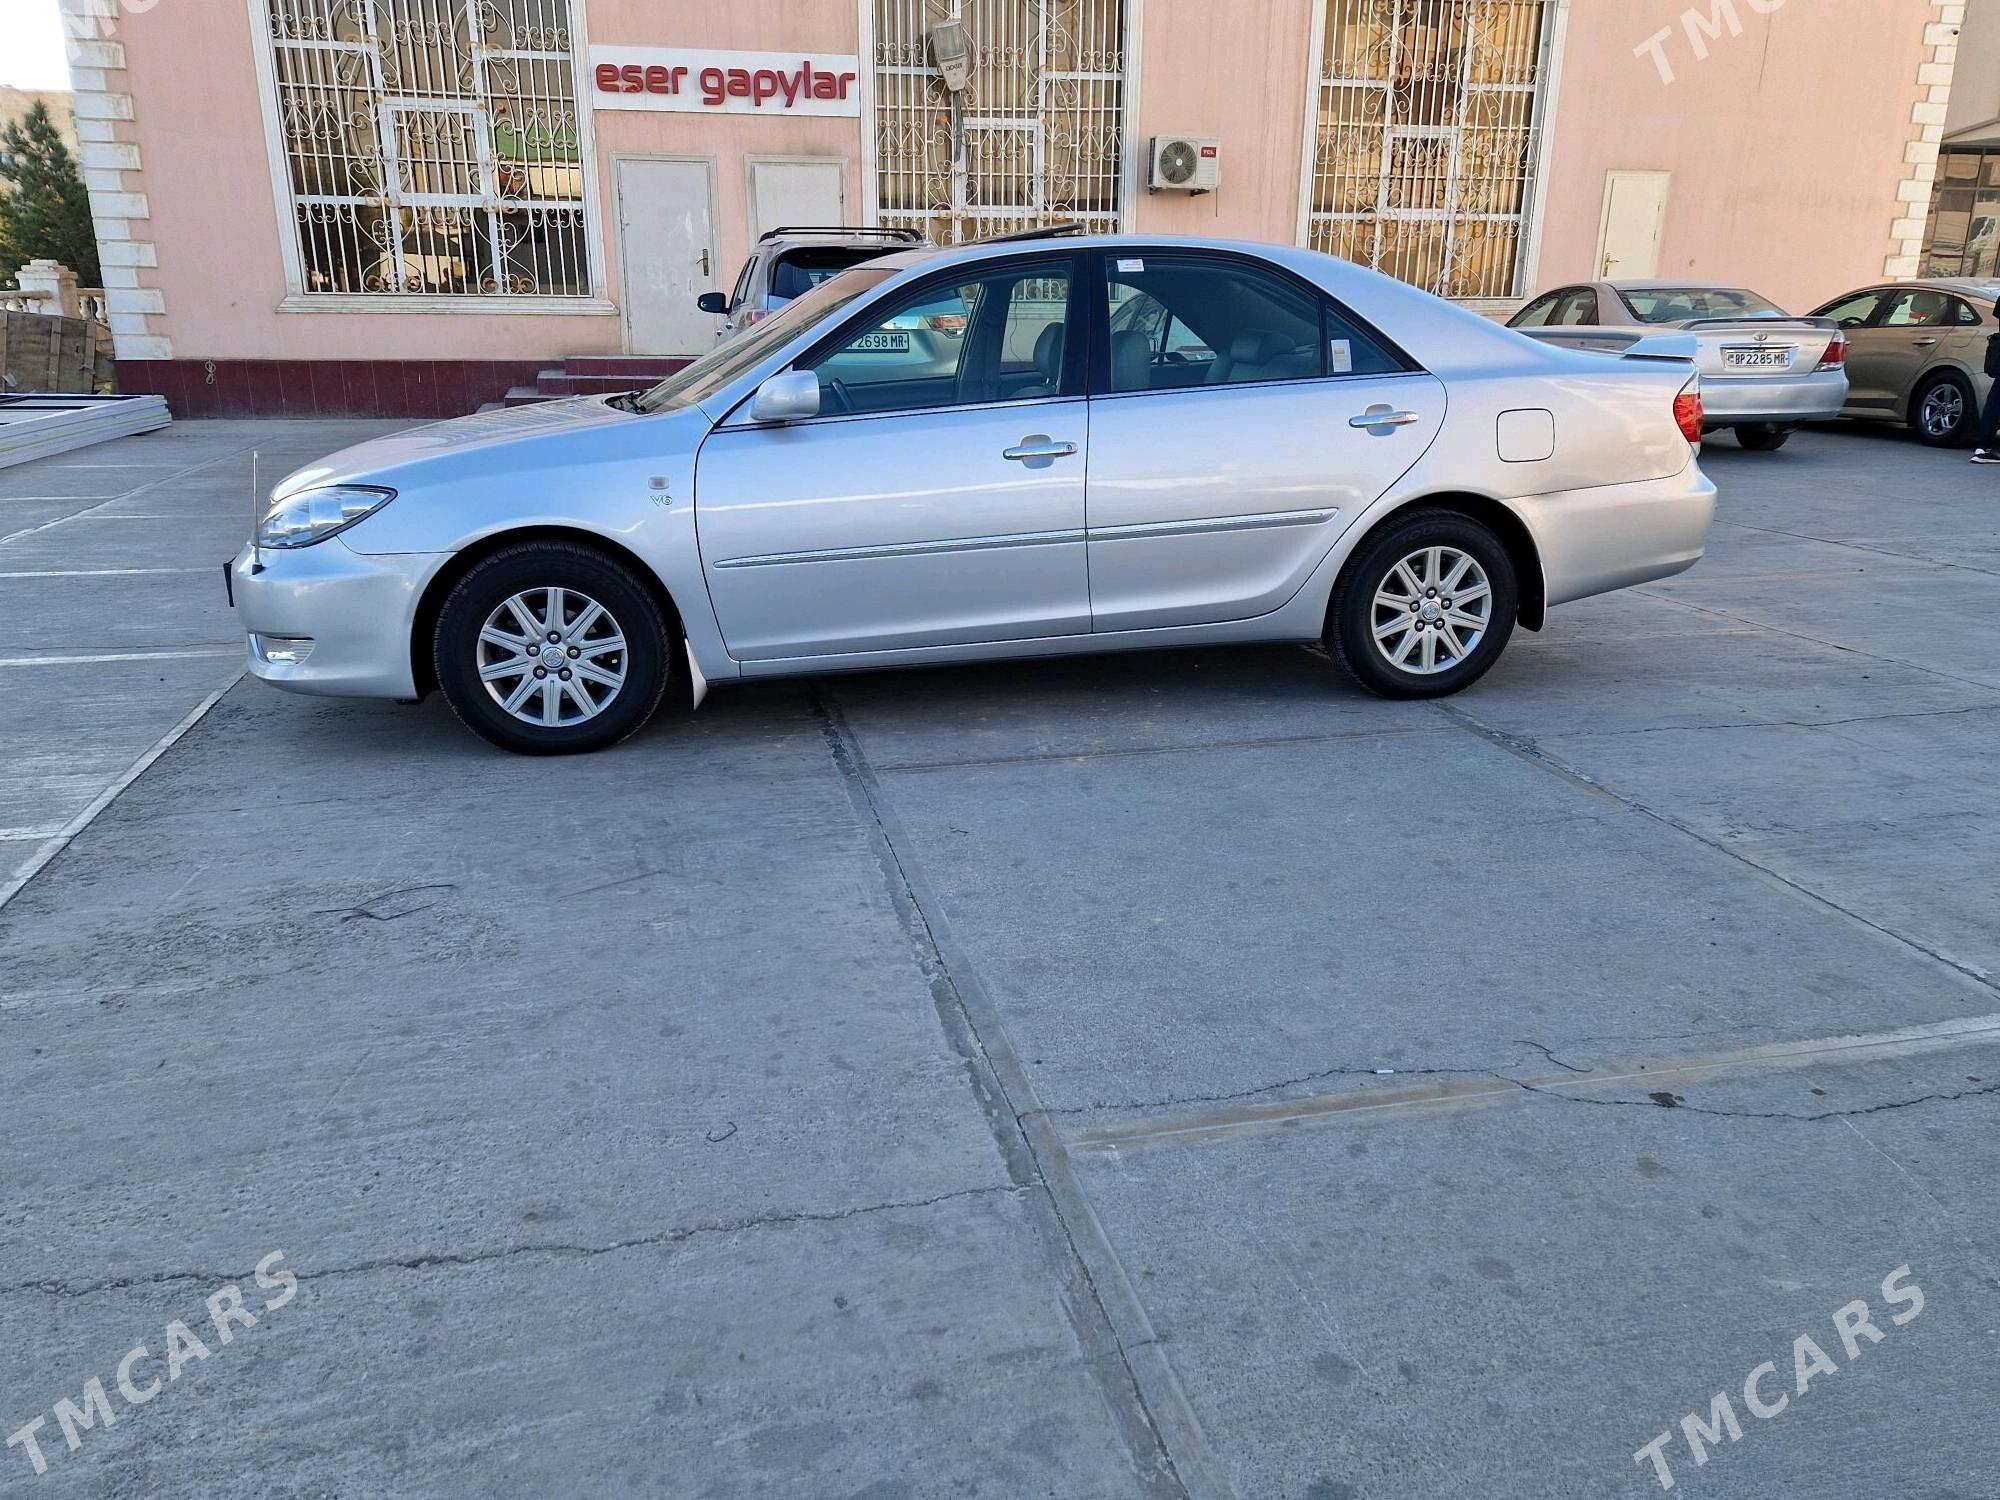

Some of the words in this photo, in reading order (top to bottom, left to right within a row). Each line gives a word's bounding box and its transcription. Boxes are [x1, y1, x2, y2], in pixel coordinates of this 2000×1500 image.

[595, 63, 688, 95] eser
[699, 61, 856, 108] gapylar
[890, 335, 904, 348] MR
[1735, 353, 1745, 365] BP
[1746, 353, 1772, 365] 2285
[1773, 353, 1786, 365] MR
[649, 494, 673, 507] V6
